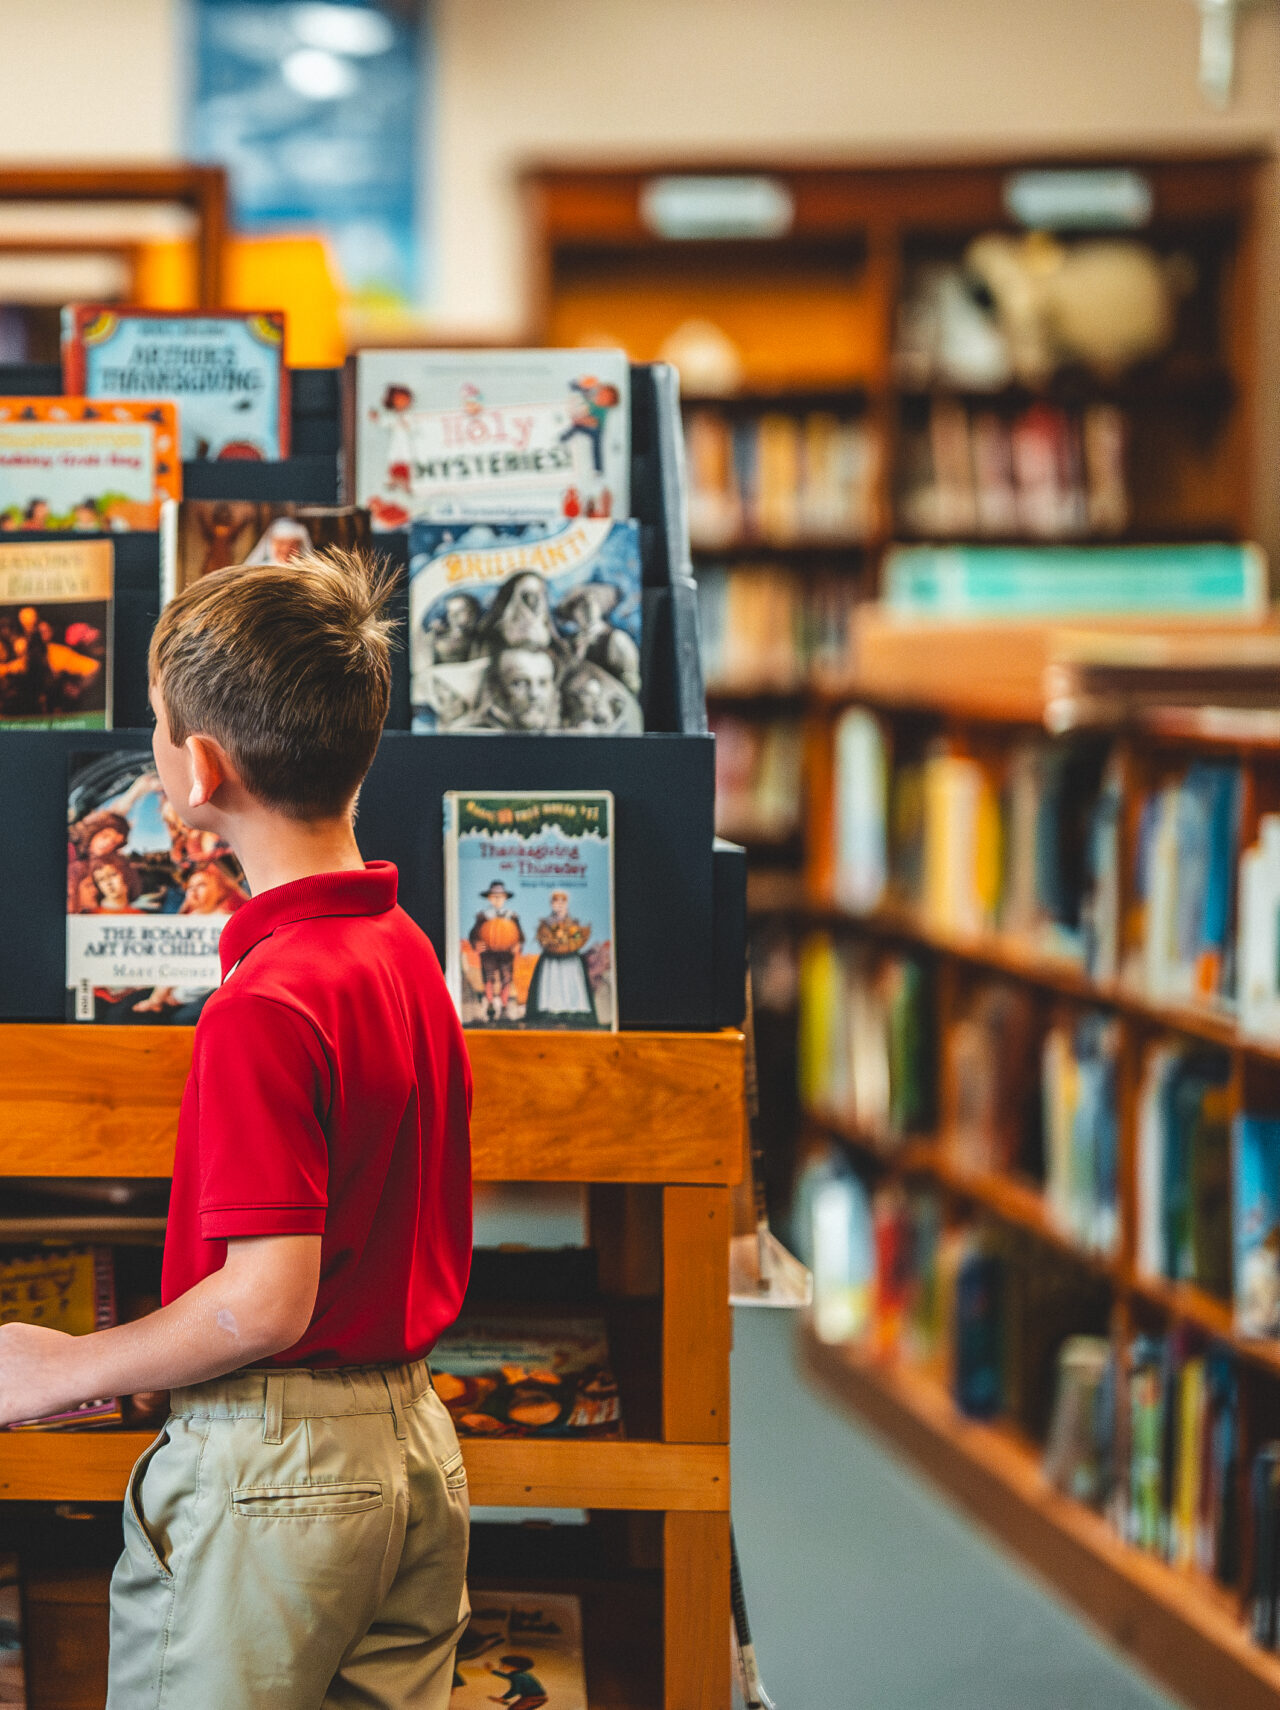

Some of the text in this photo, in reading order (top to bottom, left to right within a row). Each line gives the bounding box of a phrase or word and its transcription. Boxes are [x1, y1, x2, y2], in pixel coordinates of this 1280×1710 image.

[479, 842, 580, 860] Thanksgiving
[518, 860, 588, 879] Thursday
[101, 926, 137, 941] THE
[141, 926, 205, 941] ROSARY
[84, 941, 118, 957] ART
[122, 941, 156, 956] FOR
